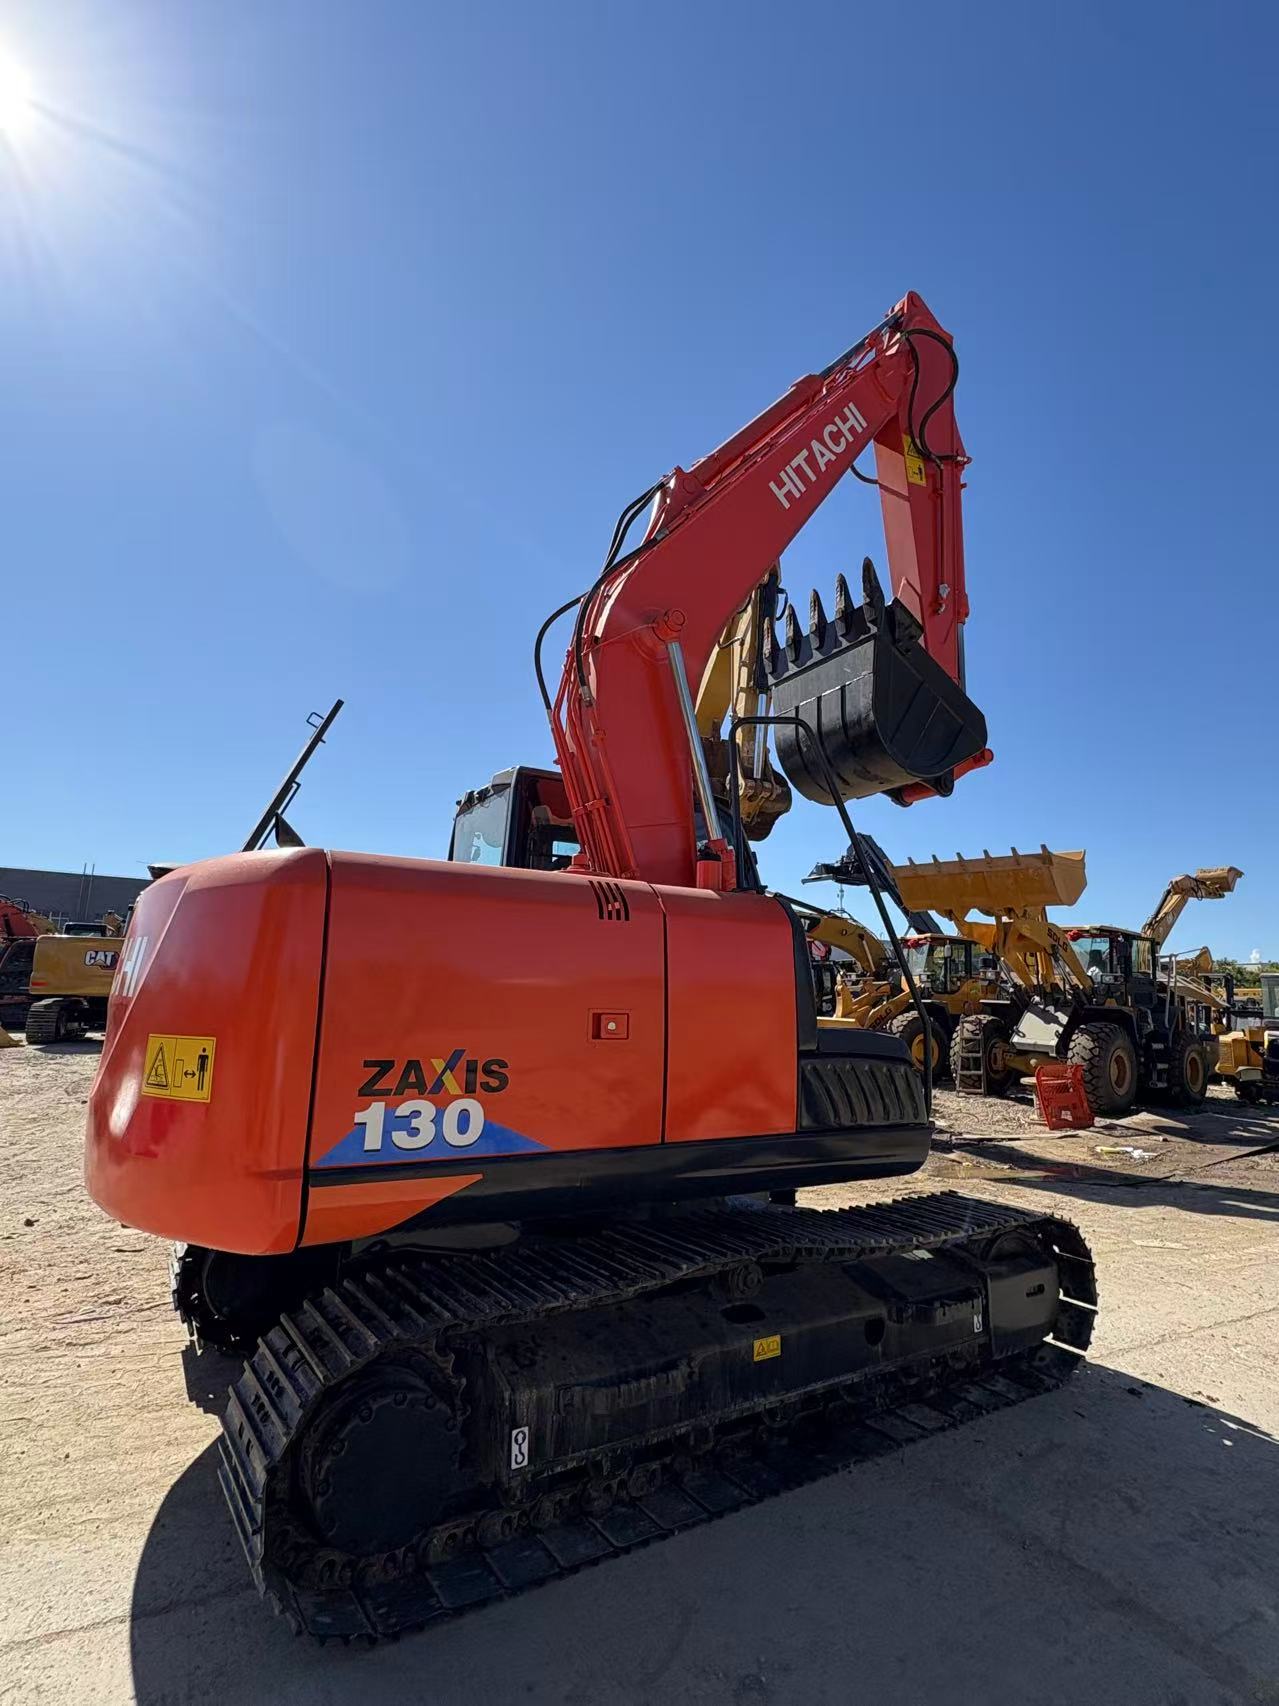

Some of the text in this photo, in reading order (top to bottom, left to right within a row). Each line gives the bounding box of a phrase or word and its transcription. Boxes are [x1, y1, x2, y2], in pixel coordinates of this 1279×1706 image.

[768, 401, 868, 510] HITACHI
[85, 950, 115, 966] CAT
[1047, 926, 1068, 953] SDLG
[357, 1048, 510, 1097] ZAXIS
[354, 1098, 485, 1152] 130
